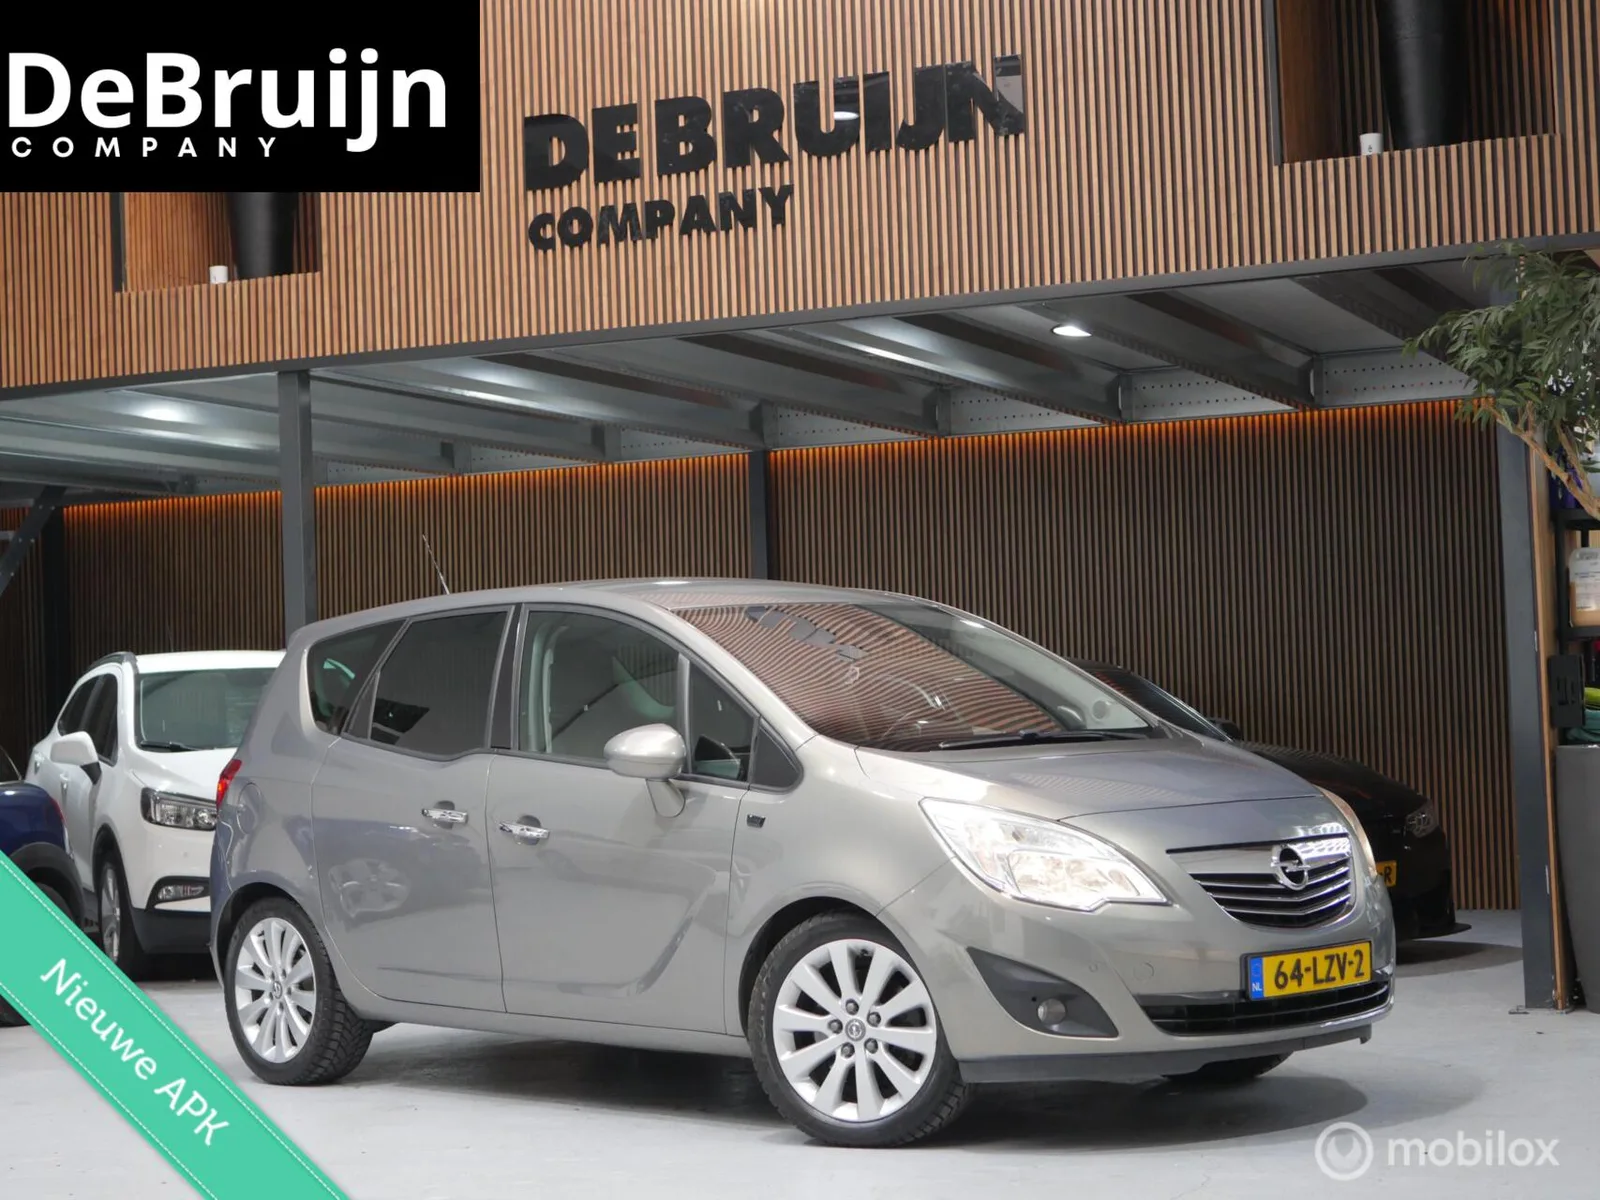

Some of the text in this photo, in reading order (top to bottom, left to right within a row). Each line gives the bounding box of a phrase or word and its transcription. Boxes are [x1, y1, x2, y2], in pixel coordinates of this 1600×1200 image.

[528, 183, 794, 252] COMPANY
[1252, 982, 1262, 992] NL
[1274, 949, 1365, 990] 64-LZV-2
